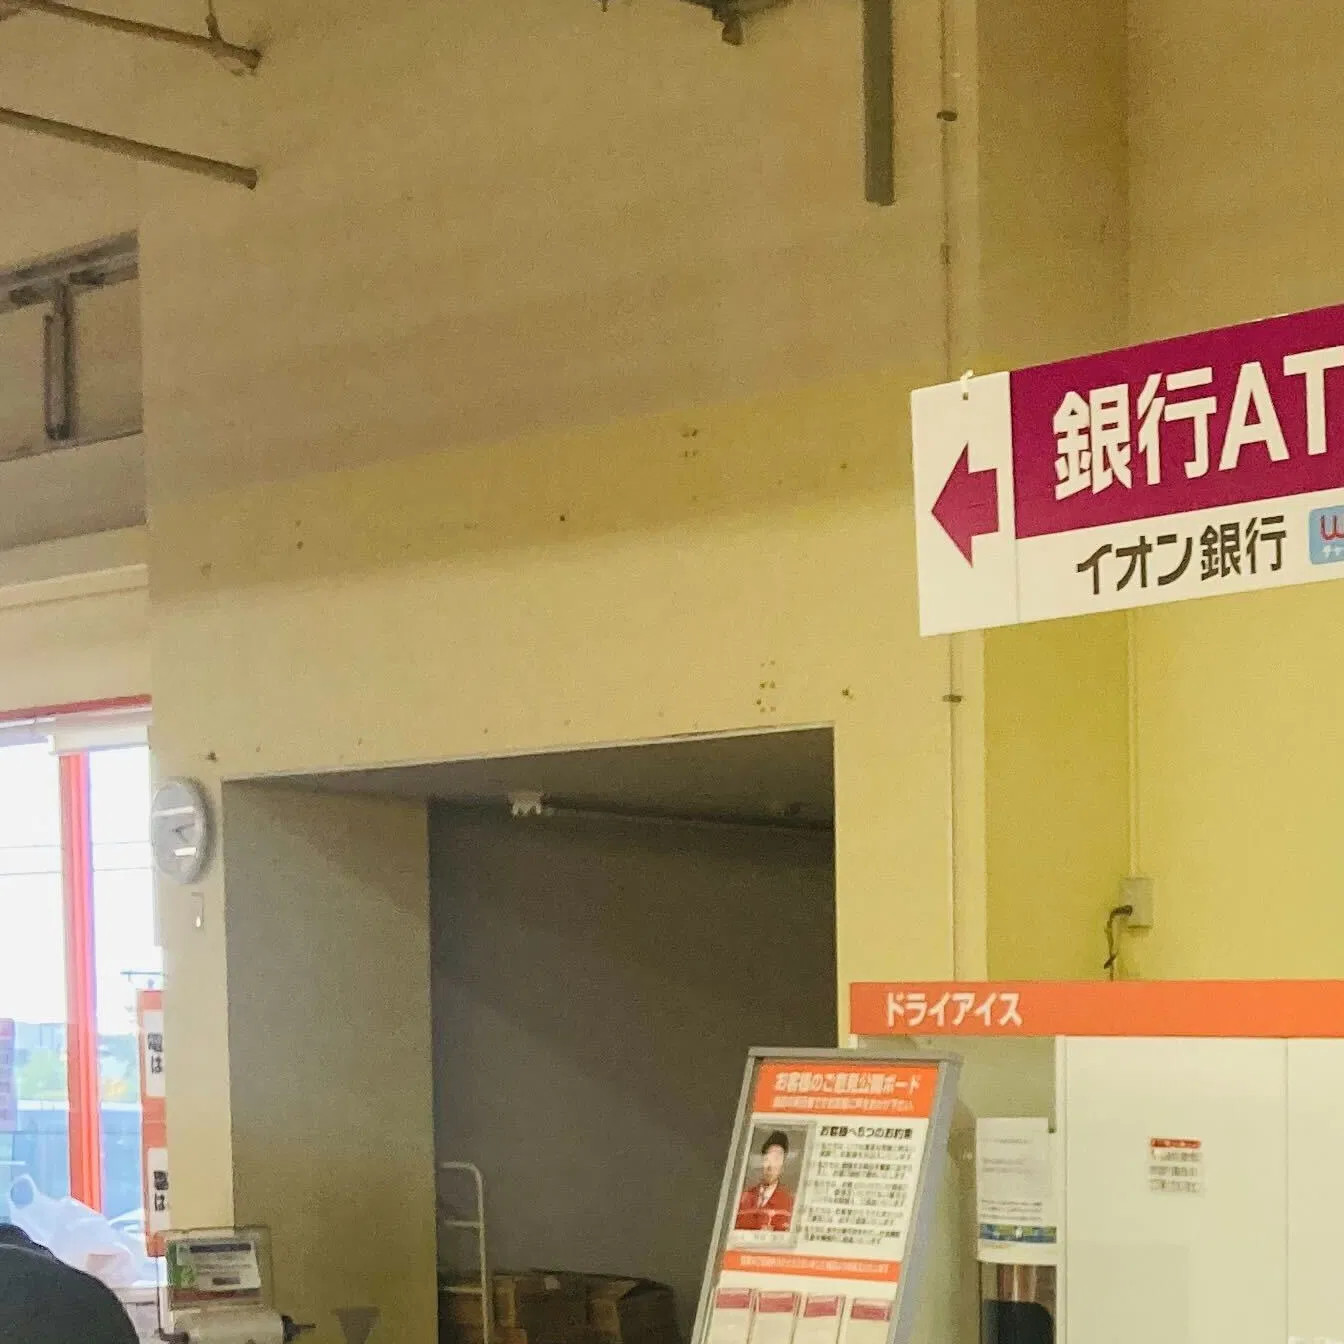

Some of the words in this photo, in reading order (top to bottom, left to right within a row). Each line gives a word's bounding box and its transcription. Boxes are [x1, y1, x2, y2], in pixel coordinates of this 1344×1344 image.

[1077, 515, 1287, 594] イオン銀行
[887, 992, 1022, 1026] ドライアイス
